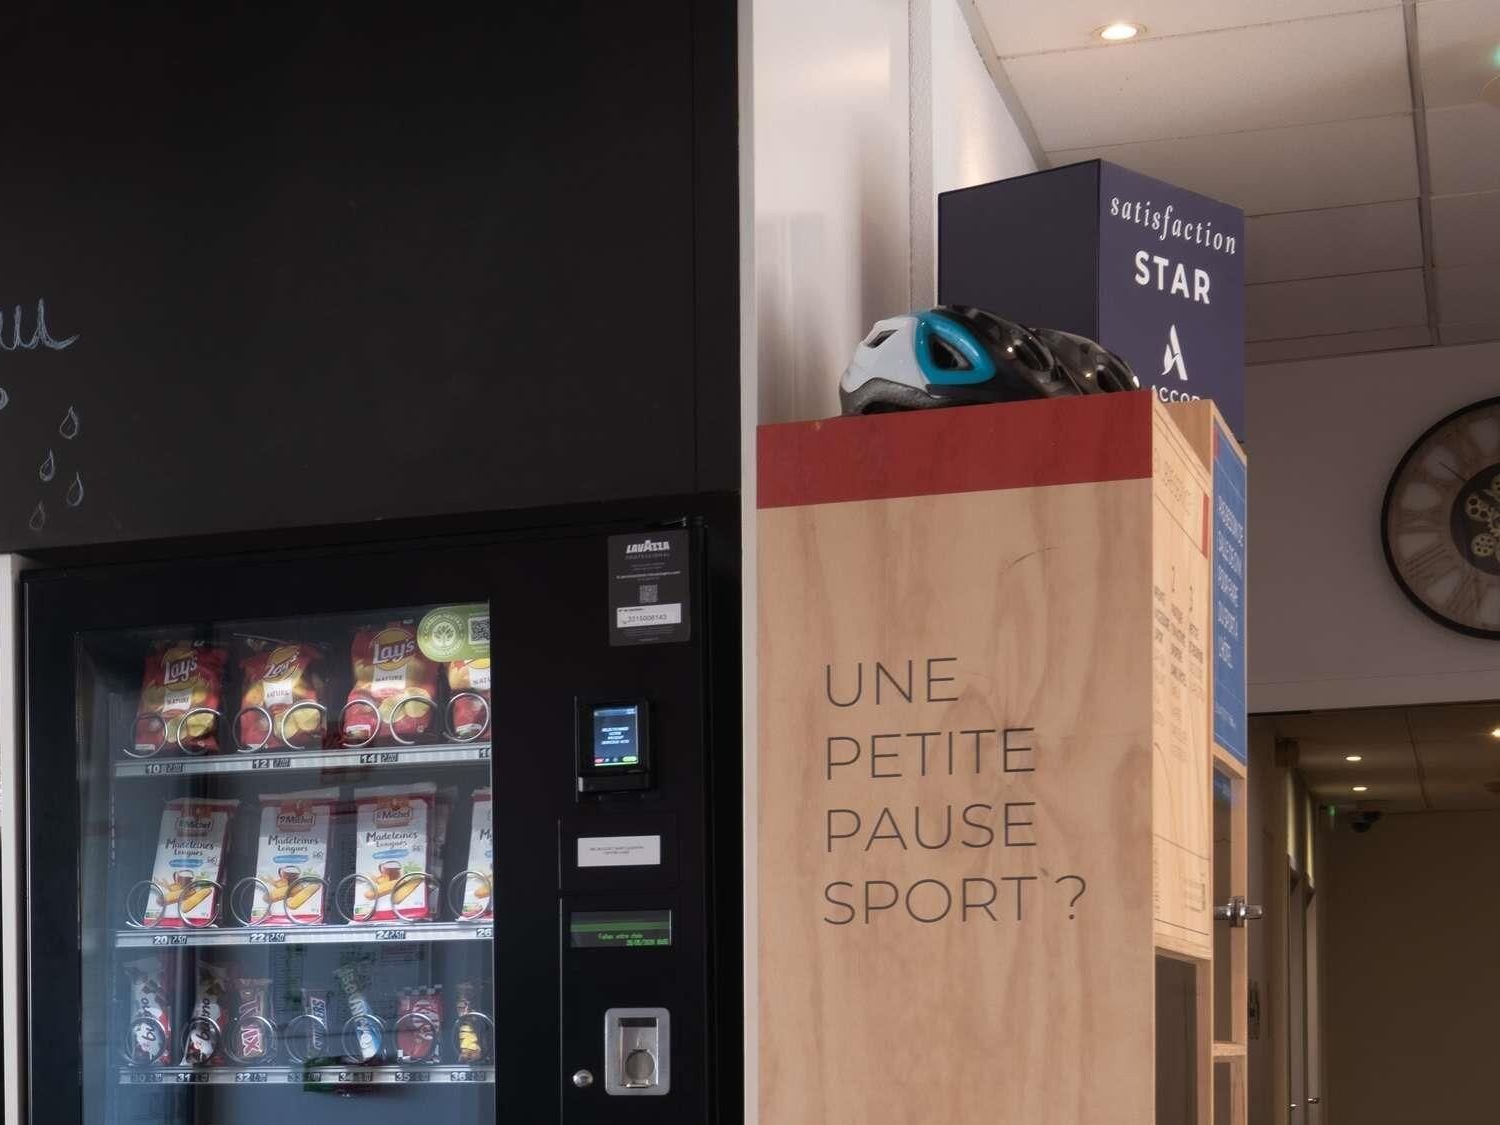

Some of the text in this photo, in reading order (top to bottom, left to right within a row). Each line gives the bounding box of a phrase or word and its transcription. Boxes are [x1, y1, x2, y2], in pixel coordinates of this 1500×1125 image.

[1110, 197, 1237, 255] satisfaction
[1135, 250, 1210, 304] STAR
[1152, 385, 1200, 402] CCO
[372, 639, 416, 665] Lay's
[163, 656, 199, 685] Lay's
[826, 657, 959, 708] UNE
[826, 727, 1036, 781] PETITE
[826, 802, 1037, 853] PAUSE
[366, 831, 419, 843] Madeleines
[824, 875, 1086, 925] SPORT ?
[153, 935, 168, 944] 20
[250, 933, 267, 943] 22
[376, 930, 389, 939] 24
[177, 1073, 190, 1082] 31
[236, 1073, 250, 1082] 32
[395, 1072, 410, 1081] 35
[451, 1072, 466, 1081] 36
